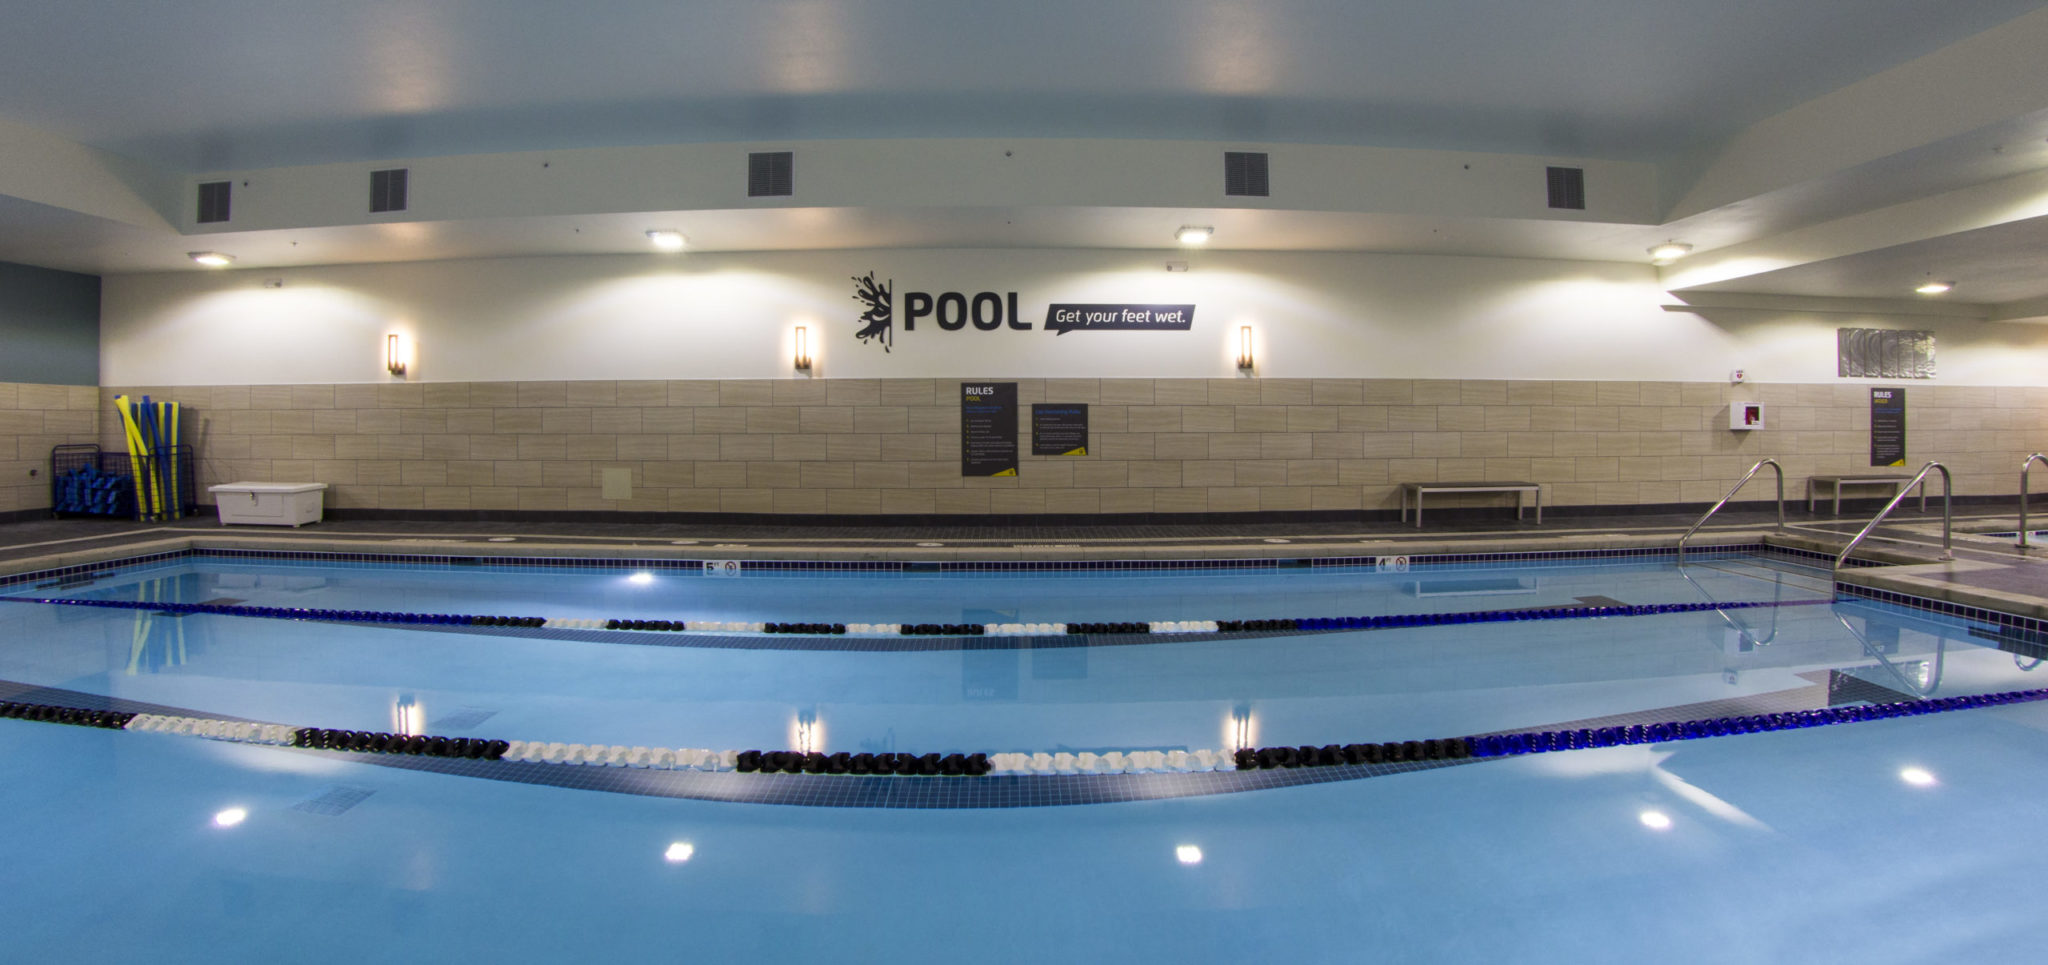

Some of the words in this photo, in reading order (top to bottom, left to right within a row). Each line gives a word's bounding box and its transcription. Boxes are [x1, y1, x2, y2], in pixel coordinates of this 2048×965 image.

[904, 292, 1032, 331] POOL
[1056, 309, 1081, 323] Get
[1085, 312, 1119, 326] your
[1121, 309, 1151, 323] feet
[1154, 310, 1186, 323] wet.
[966, 387, 994, 395] RULES
